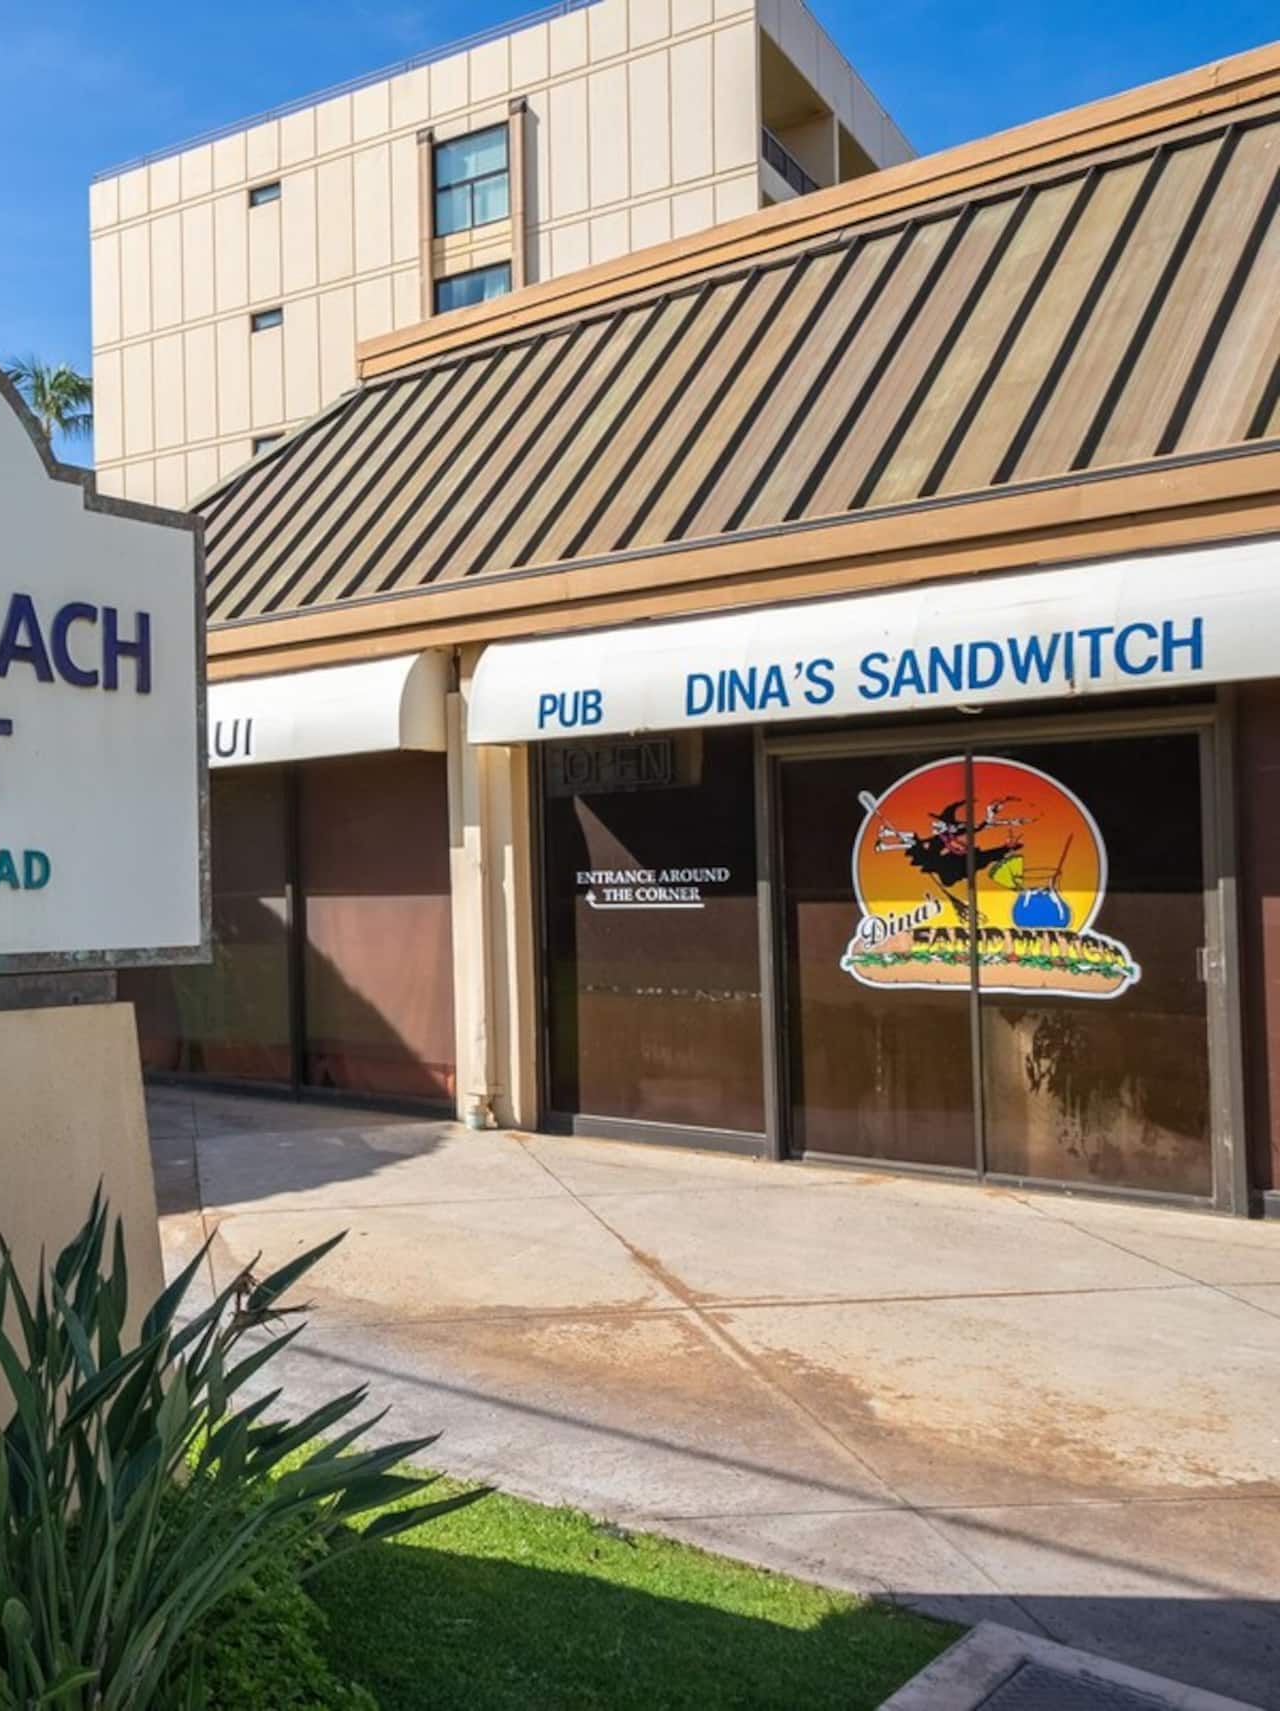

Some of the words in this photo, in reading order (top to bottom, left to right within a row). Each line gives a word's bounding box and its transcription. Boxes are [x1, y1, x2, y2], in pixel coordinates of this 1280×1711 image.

[685, 658, 836, 716] DINA'S
[858, 616, 1204, 700] SANDWITCH
[538, 689, 604, 729] PUB
[208, 717, 253, 758] UI
[576, 869, 656, 884] ENTRANCE
[658, 867, 731, 883] AROUND
[602, 888, 633, 902] THE
[634, 886, 702, 902] CORNER
[861, 893, 942, 947] Dina's
